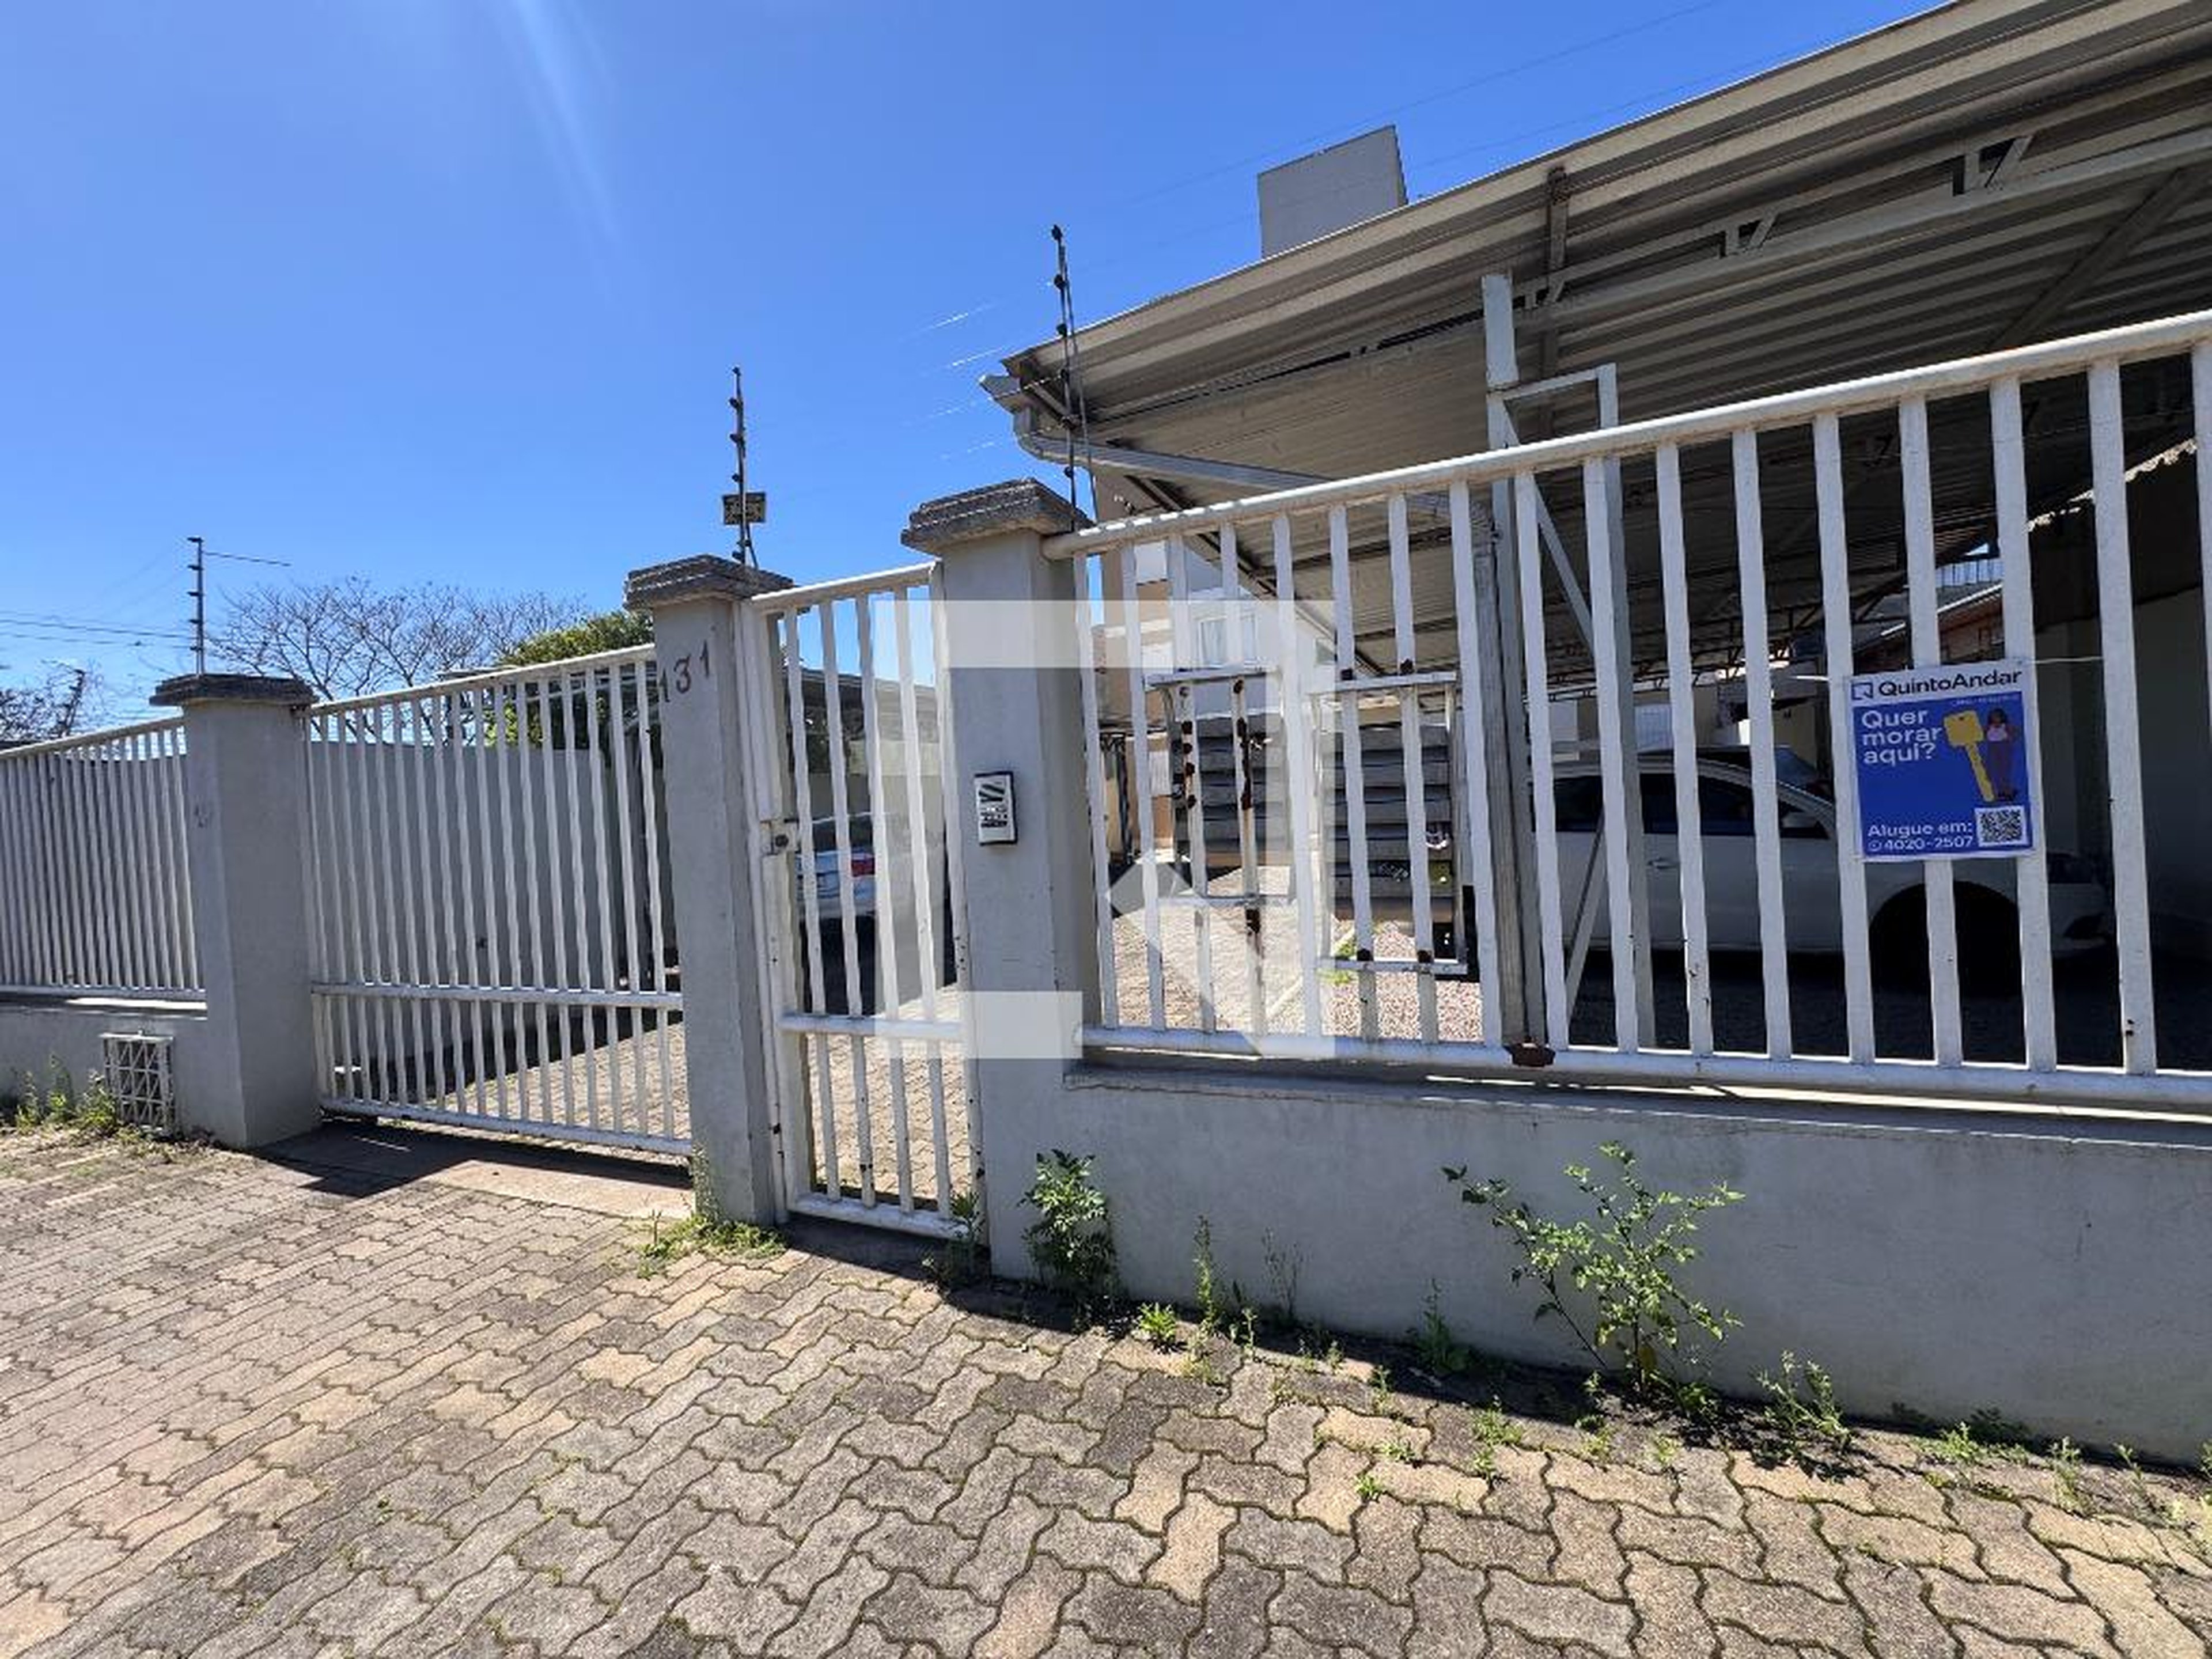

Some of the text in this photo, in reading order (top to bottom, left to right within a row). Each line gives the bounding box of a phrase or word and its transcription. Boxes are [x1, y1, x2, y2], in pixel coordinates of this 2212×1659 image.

[659, 640, 710, 702] 131
[1878, 669, 2022, 696] QuintoAndar
[1862, 710, 1927, 729] Quer
[1862, 728, 1942, 747] morar
[1863, 743, 1937, 766] aqui?
[1868, 823, 1973, 839] Alugue em:
[1885, 836, 1973, 850] 4020-2507
